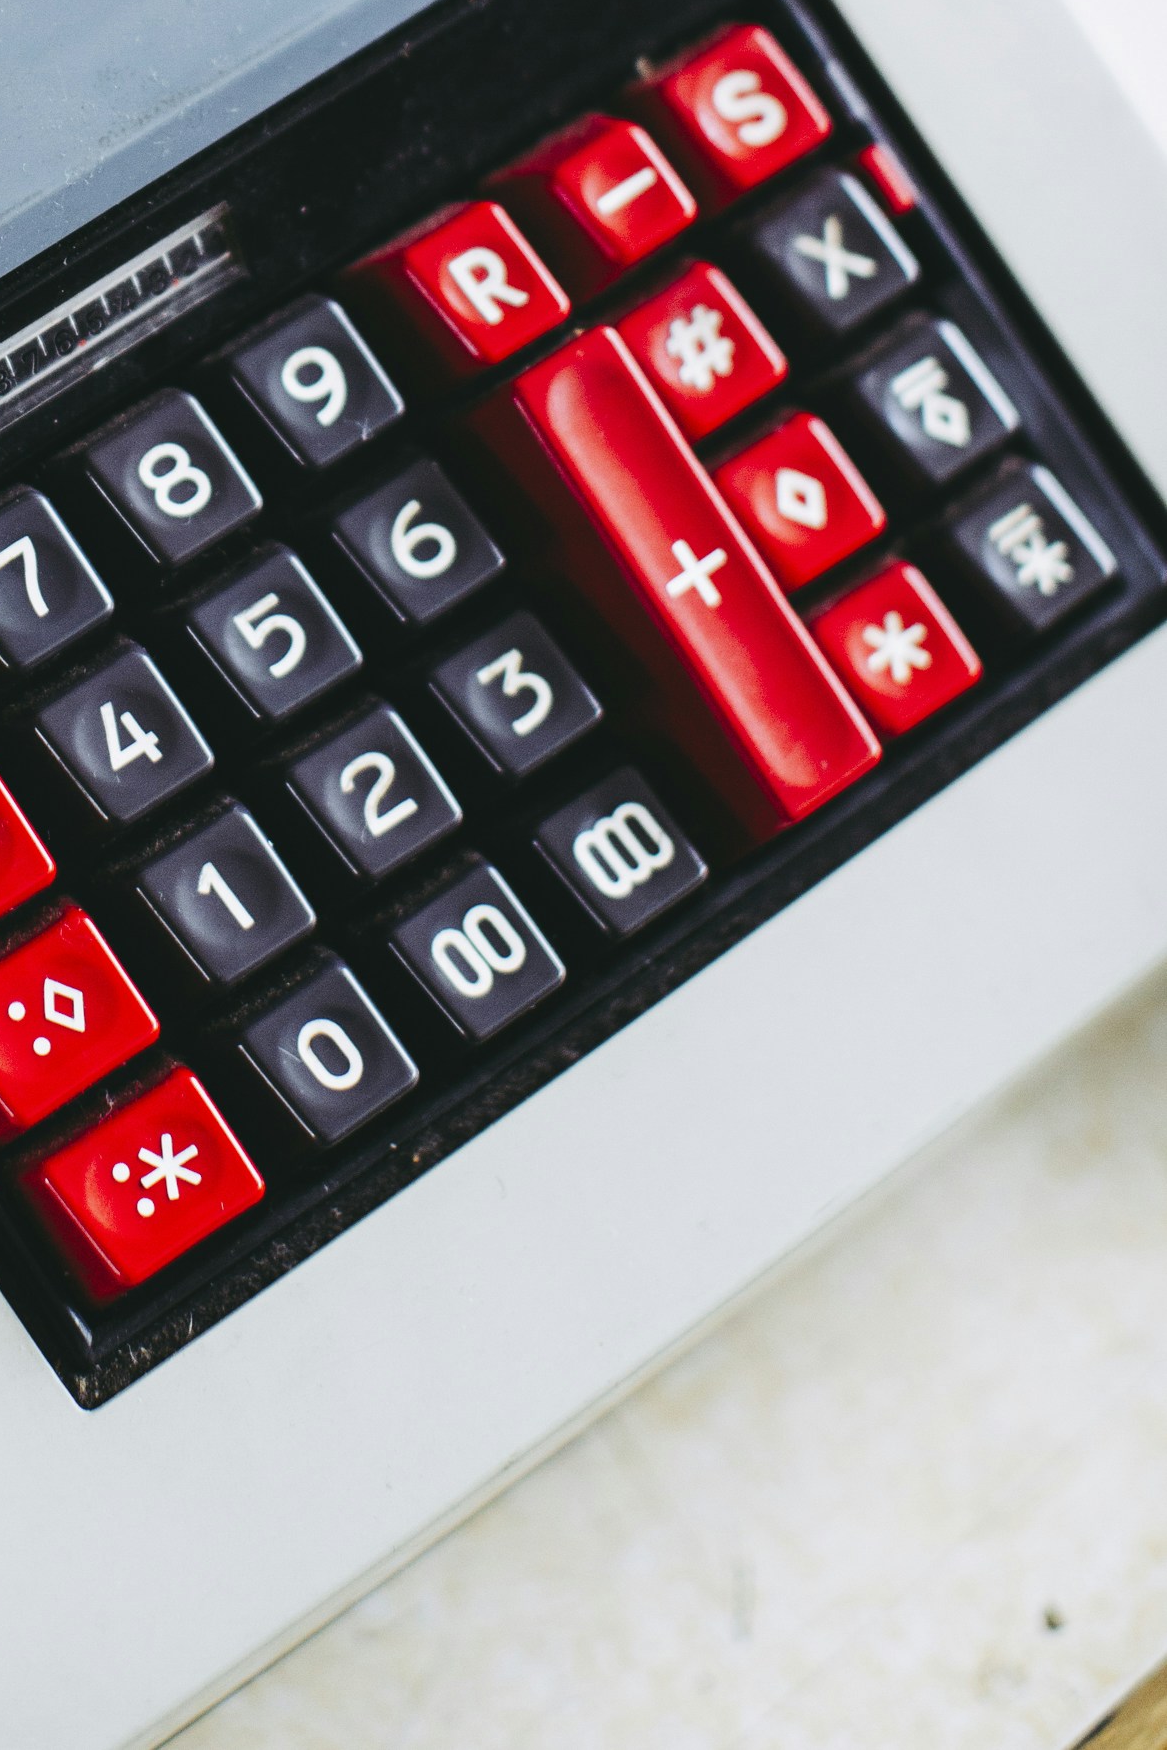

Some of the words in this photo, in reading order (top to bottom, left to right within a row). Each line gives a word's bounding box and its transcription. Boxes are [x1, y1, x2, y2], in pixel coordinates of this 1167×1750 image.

[711, 70, 786, 147] S
[448, 246, 529, 326] R
[788, 213, 875, 300] X
[281, 346, 347, 426] 9
[138, 442, 212, 518] 8
[390, 499, 456, 578] 6
[234, 592, 307, 678] 5
[476, 648, 553, 736] 3
[99, 702, 162, 772] 4
[339, 751, 418, 837] 2
[198, 862, 255, 929] 1
[432, 904, 526, 998] 00
[297, 1018, 364, 1091] 0
